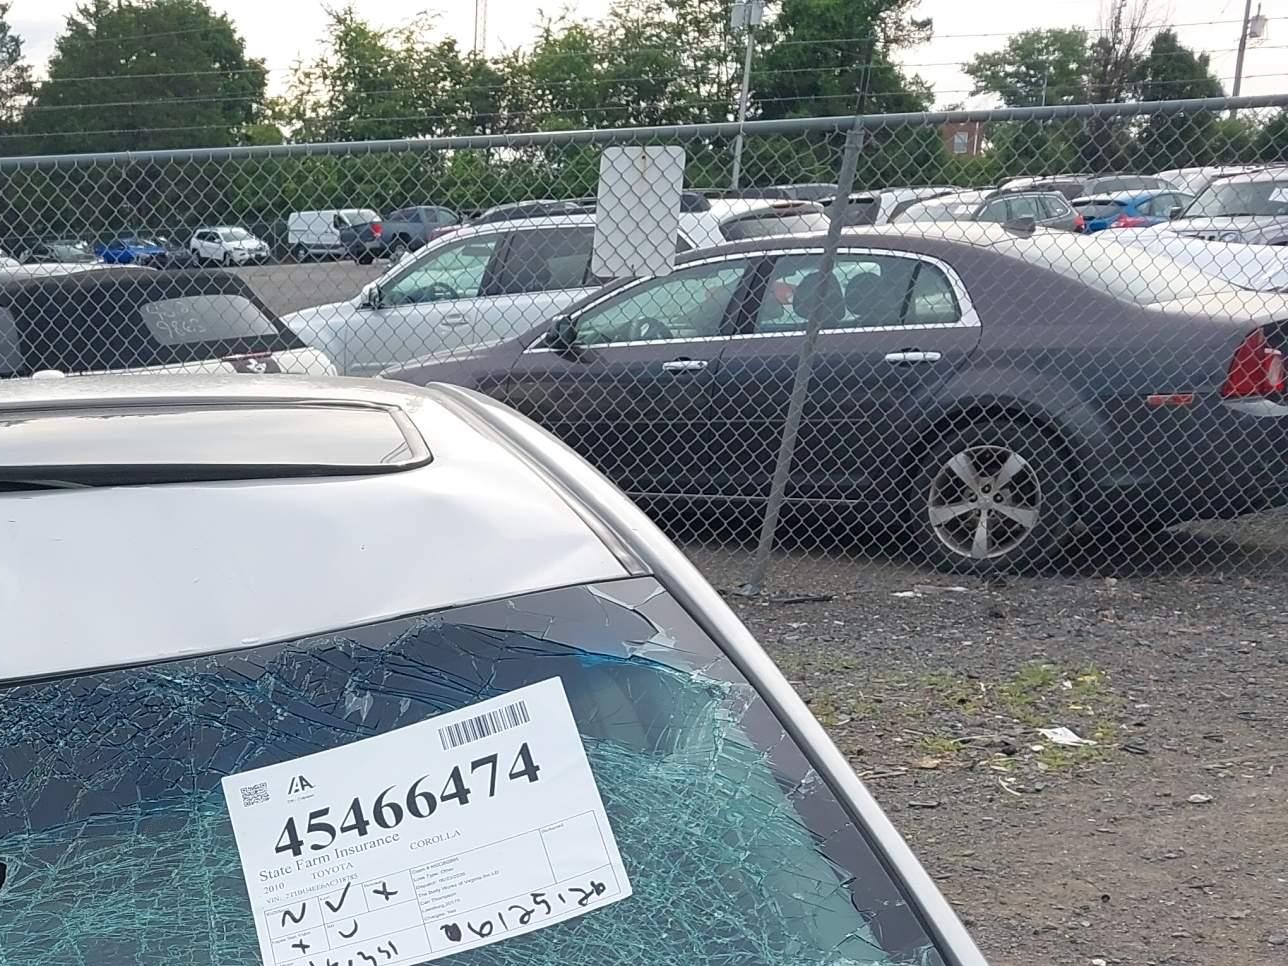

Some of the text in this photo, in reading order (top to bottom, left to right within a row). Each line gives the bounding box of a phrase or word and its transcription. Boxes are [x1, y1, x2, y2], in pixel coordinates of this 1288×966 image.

[274, 742, 541, 857] 45466474
[259, 833, 400, 882] State Farm Insurance
[263, 829, 462, 895] 2010 TOYOTA COROLLA
